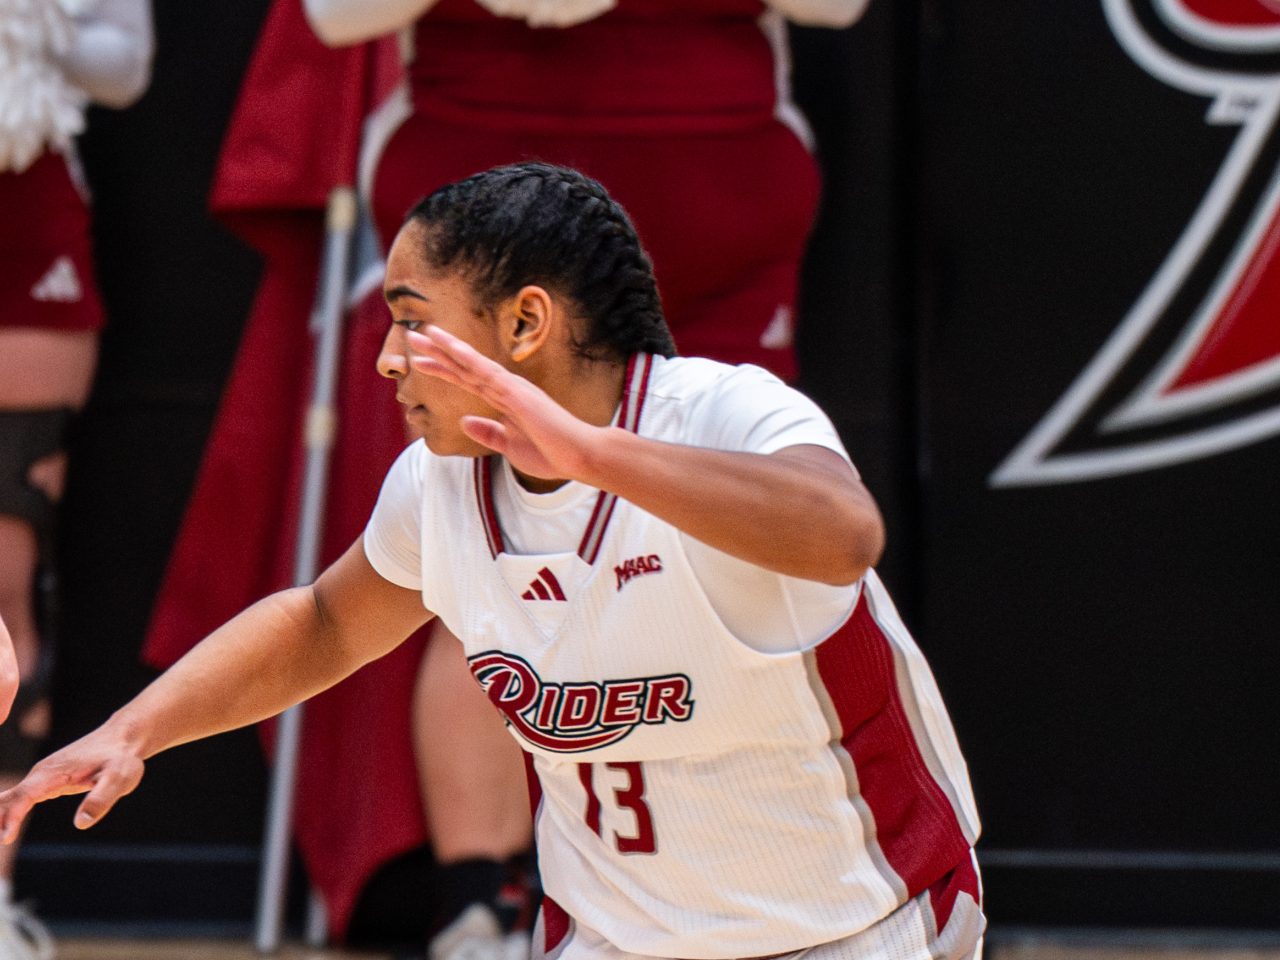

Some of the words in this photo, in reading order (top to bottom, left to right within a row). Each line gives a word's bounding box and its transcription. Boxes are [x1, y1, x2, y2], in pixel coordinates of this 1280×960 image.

[614, 554, 663, 591] MAAC
[467, 650, 695, 753] RIDER
[577, 761, 658, 855] 13
